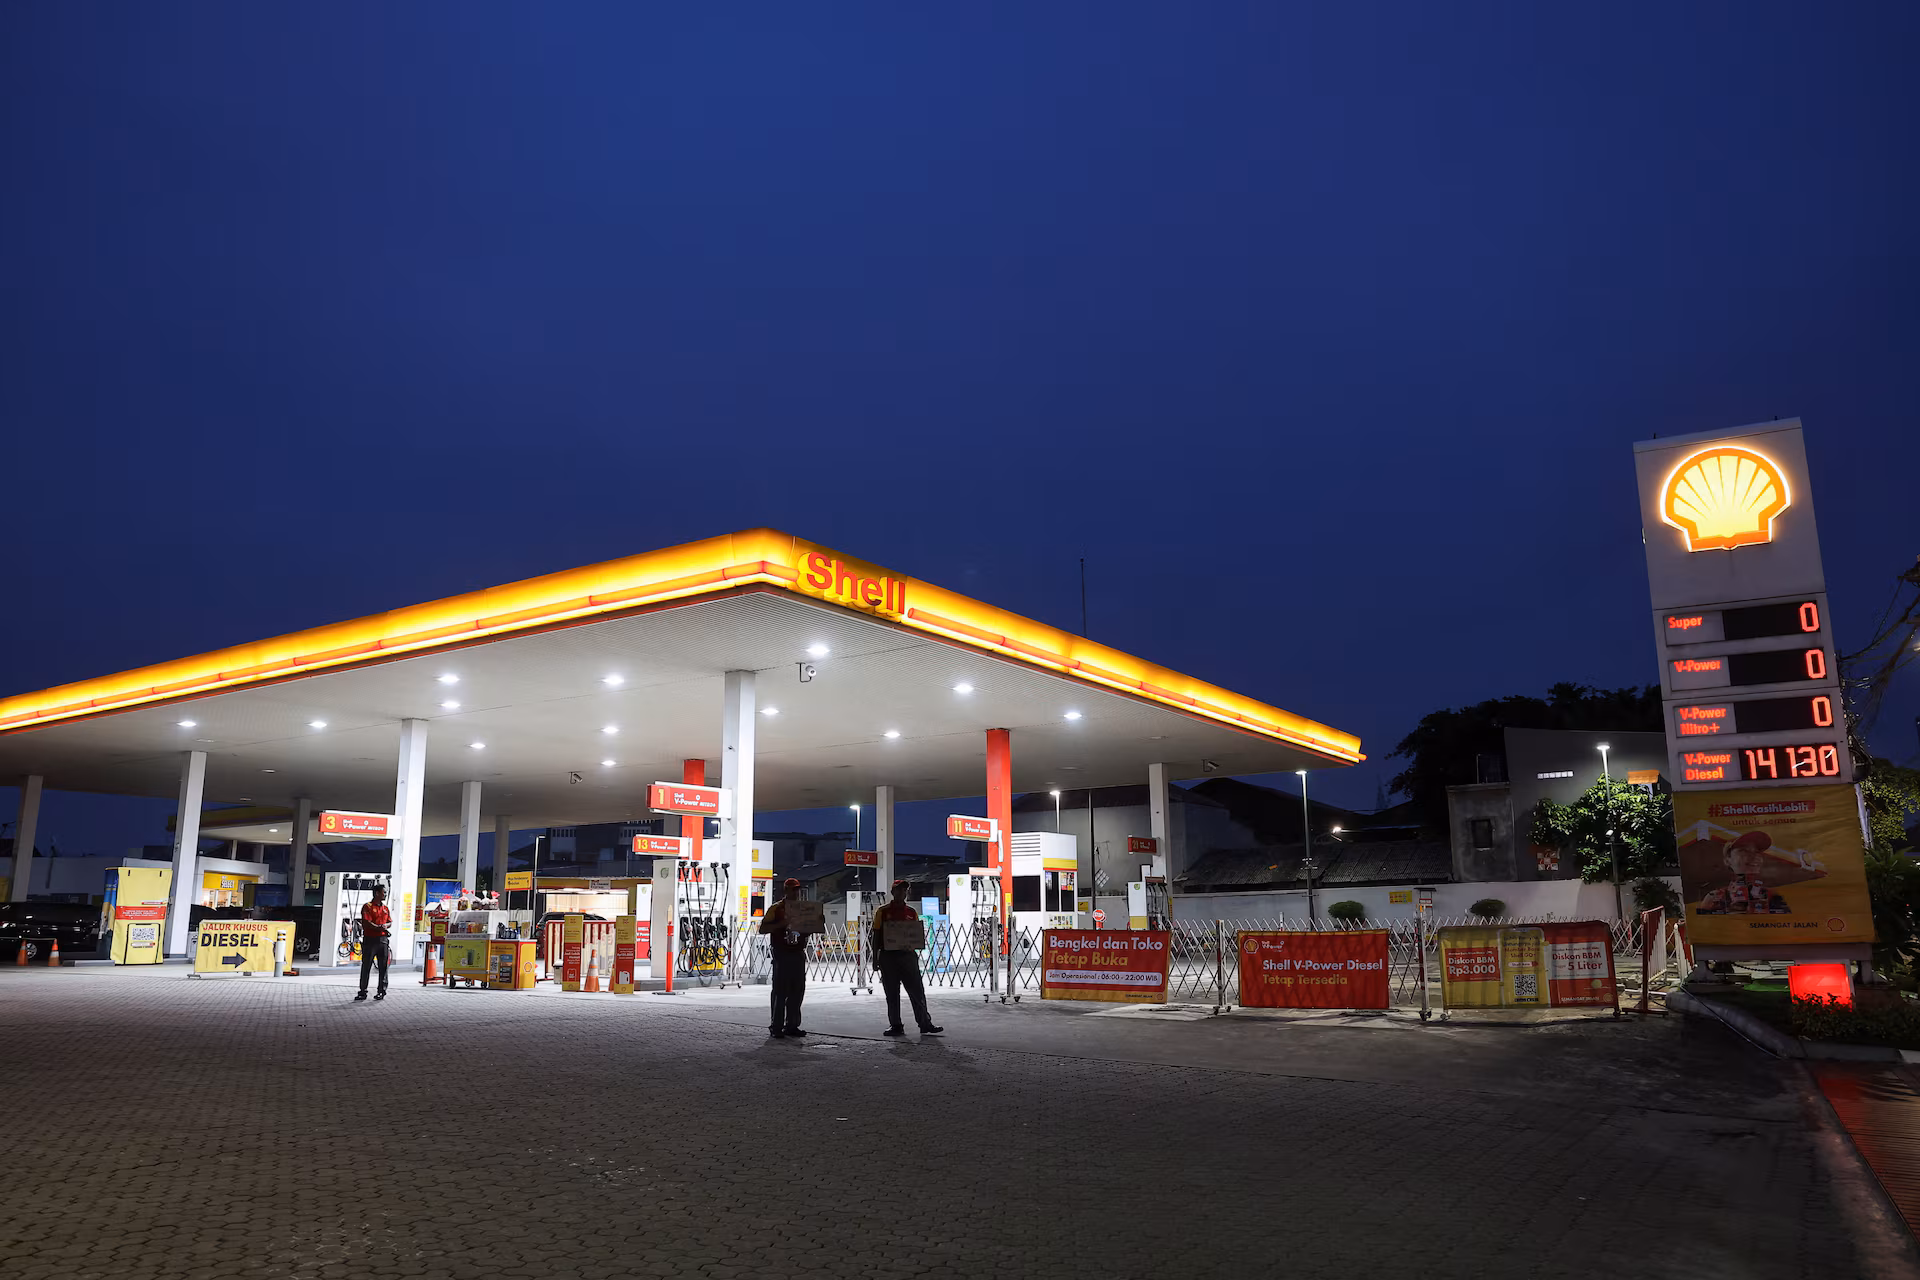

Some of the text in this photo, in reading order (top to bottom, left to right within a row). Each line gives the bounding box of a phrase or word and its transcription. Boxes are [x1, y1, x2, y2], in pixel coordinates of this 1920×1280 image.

[807, 552, 905, 614] Shell
[1668, 616, 1703, 630] Super
[1799, 602, 1820, 632] 0
[1673, 660, 1721, 672] V-Power
[1805, 649, 1826, 679] 0
[1679, 707, 1727, 720] V-Power
[1811, 696, 1833, 727] 0
[1680, 722, 1721, 735] Nitro+
[1683, 752, 1732, 765] V-Power
[1685, 766, 1725, 781] Diesel
[658, 788, 665, 805] 1
[674, 798, 699, 806] V-Power
[1708, 802, 1809, 817] #ShellKasihLebih
[325, 816, 336, 830] 3
[953, 820, 963, 833] 11
[637, 839, 648, 850] 13
[847, 854, 857, 862] 23
[203, 923, 231, 931] JALUR
[201, 933, 259, 947] DIESEL
[1049, 935, 1163, 952] Bengkel dan Toko
[1049, 950, 1129, 968] Tetap Buka
[1263, 959, 1383, 970] Shell V-Power Diesel
[1448, 957, 1475, 965] Diskon
[1568, 961, 1574, 970] 5
[1577, 961, 1602, 970] Liter
[1061, 972, 1097, 980] Operasional
[1449, 964, 1496, 977] Rp3.000
[1263, 974, 1348, 987] Tetap Tersedia
